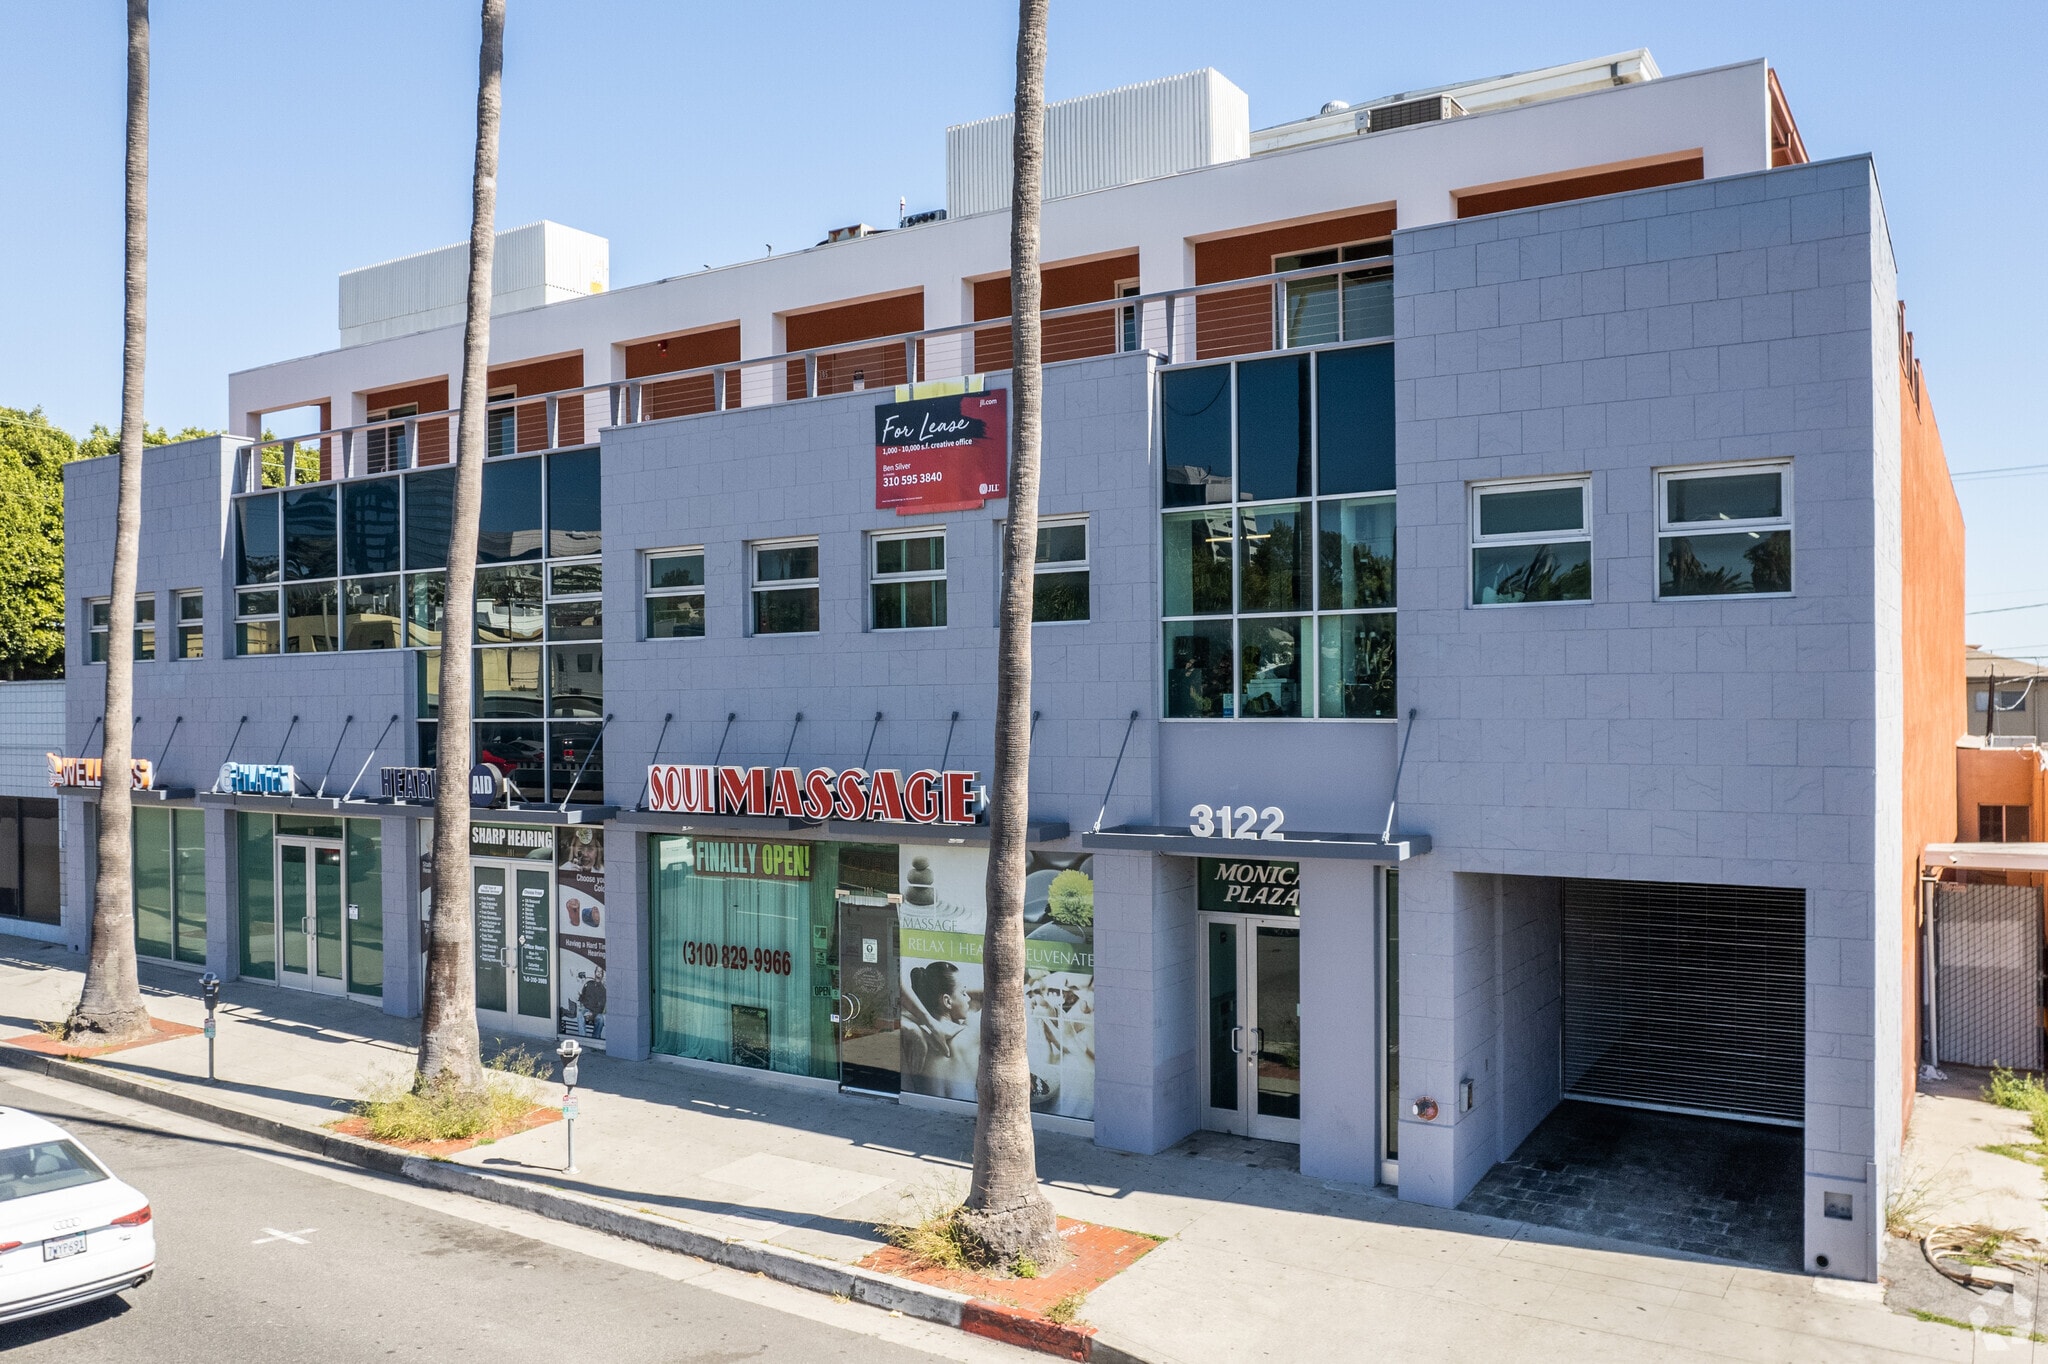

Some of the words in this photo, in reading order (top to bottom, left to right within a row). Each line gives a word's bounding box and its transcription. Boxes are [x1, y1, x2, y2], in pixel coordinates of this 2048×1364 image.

[979, 398, 997, 407] jll.com
[882, 415, 914, 443] For
[919, 412, 970, 442] Lease
[882, 446, 897, 455] 1,000
[902, 444, 920, 453] 10,000
[931, 440, 954, 449] creative
[955, 438, 973, 447] office
[882, 463, 894, 472] Ben
[894, 462, 911, 471] Silver
[883, 476, 900, 487] 310
[901, 474, 918, 485] 595
[919, 471, 942, 483] 3840
[62, 758, 149, 790] WELLS
[472, 775, 493, 795] AID
[650, 765, 714, 812] SOUL
[719, 766, 977, 825] MASSAGE
[1189, 804, 1285, 840] 3122
[472, 827, 505, 845] SHARP
[508, 829, 552, 848] HEARING
[696, 841, 757, 874] FINALLY
[761, 844, 810, 877] OPEN!
[576, 873, 596, 882] Choose
[1223, 884, 1300, 906] PLAZA
[902, 917, 958, 932] MASSAGE
[565, 939, 581, 949] Having
[586, 941, 598, 949] Hard
[908, 937, 945, 953] RELAX
[959, 942, 984, 957] HEA
[1026, 948, 1094, 968] EUVENATE
[588, 949, 606, 960] Hearing
[683, 940, 718, 968] (310)
[721, 944, 791, 976] 829-9966
